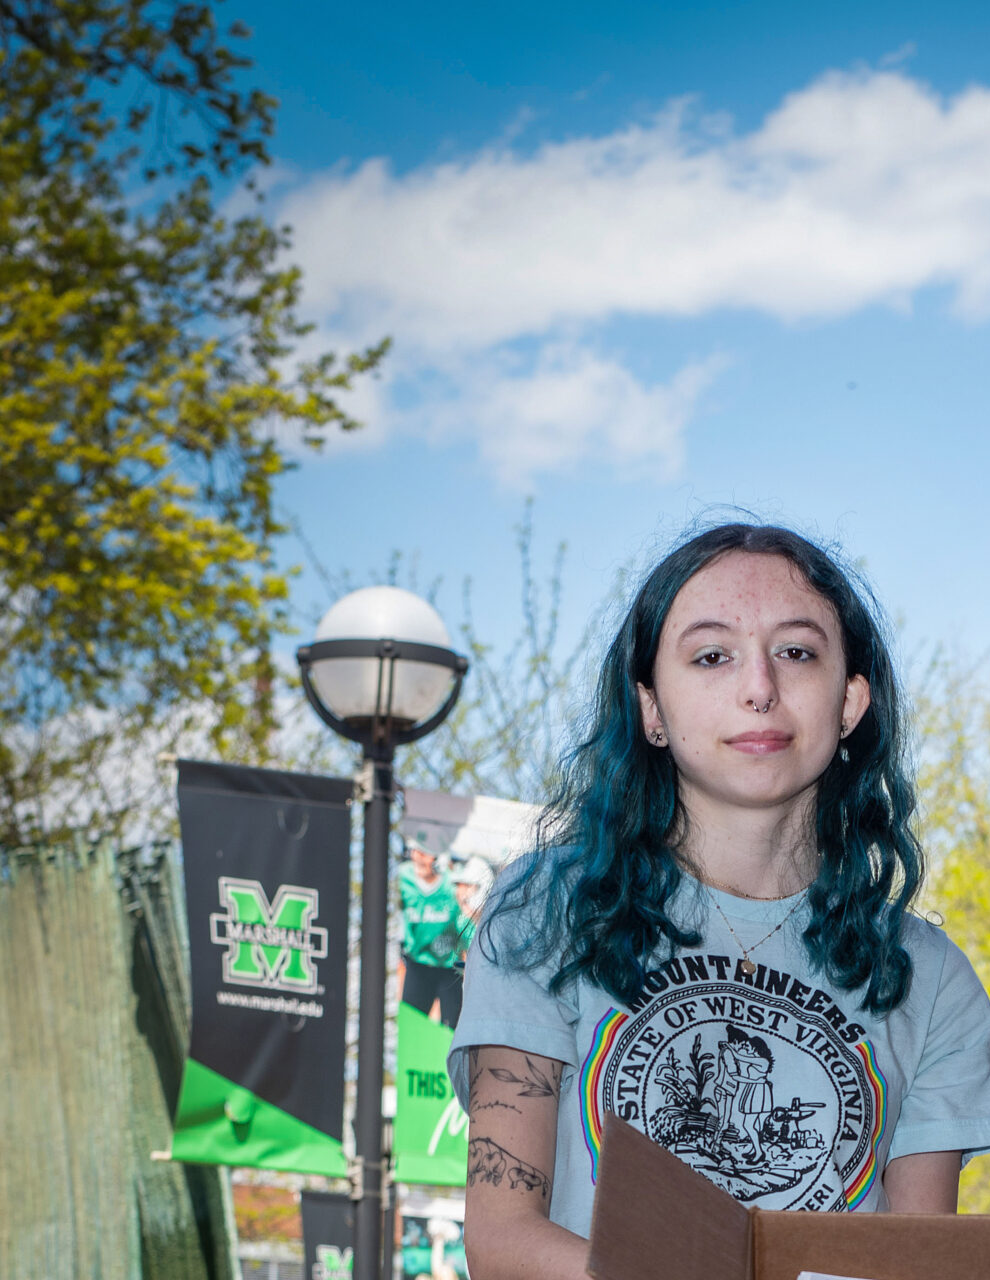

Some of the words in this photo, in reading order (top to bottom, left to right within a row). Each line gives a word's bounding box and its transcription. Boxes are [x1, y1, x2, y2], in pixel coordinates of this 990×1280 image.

[226, 920, 315, 952] MARSHALL
[406, 1069, 447, 1099] THIS
[617, 1026, 665, 1121] STATE
[663, 1000, 699, 1030] OF
[701, 996, 788, 1032] WEST
[794, 1022, 863, 1142] VIRGINIA
